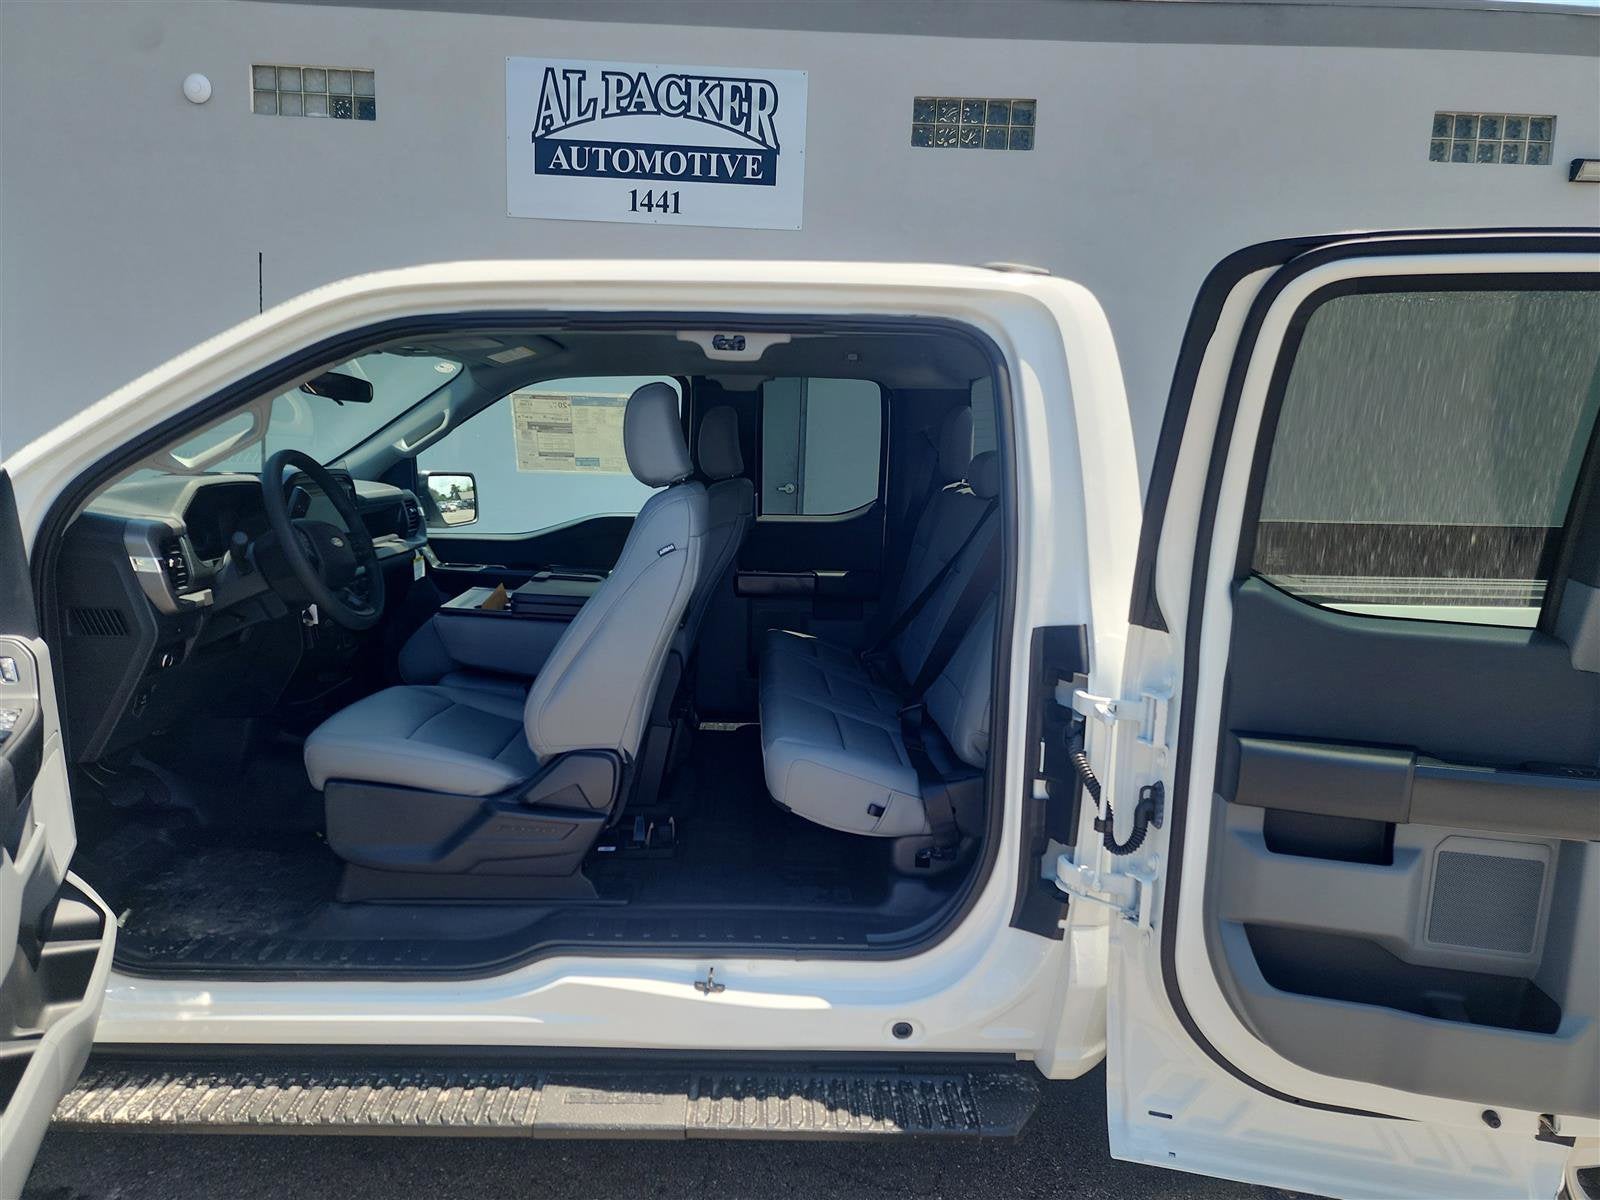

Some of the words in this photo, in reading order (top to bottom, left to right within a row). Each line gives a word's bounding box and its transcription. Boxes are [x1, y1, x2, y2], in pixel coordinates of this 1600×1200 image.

[532, 67, 598, 142] AL
[601, 70, 780, 155] PACKER
[548, 145, 764, 179] AUTOMOTIVE
[628, 188, 681, 214] 1441
